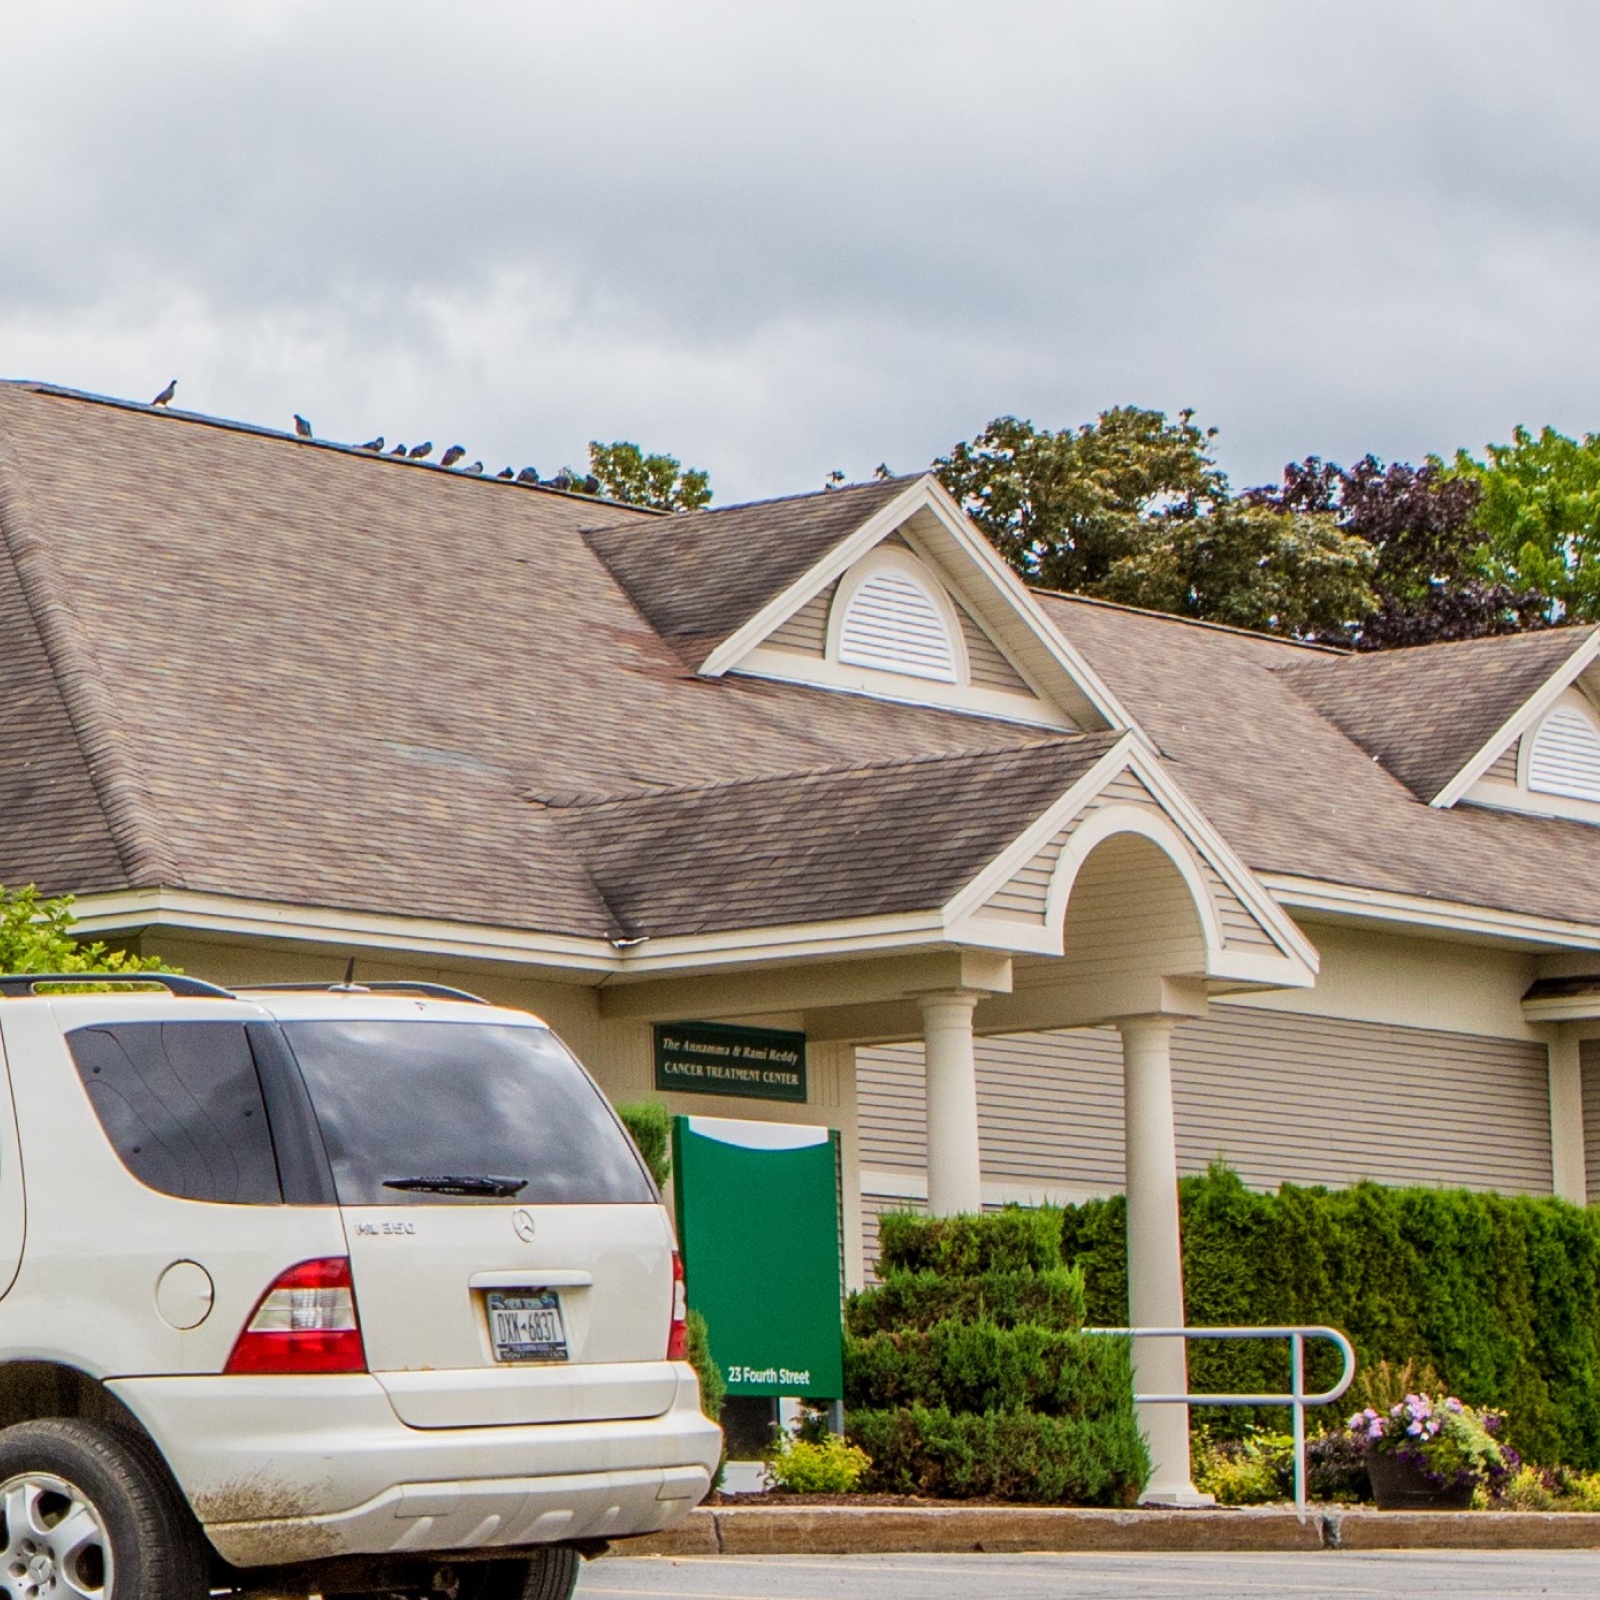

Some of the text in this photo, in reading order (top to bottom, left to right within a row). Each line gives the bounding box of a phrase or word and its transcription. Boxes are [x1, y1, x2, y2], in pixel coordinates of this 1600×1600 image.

[663, 1037, 680, 1050] The
[731, 1045, 741, 1057] &
[742, 1046, 768, 1059] Rami
[768, 1049, 799, 1066] Reddy
[664, 1061, 799, 1085] CANCER TREATMENT CENTER
[728, 1366, 810, 1385] 23 Fourth Street
